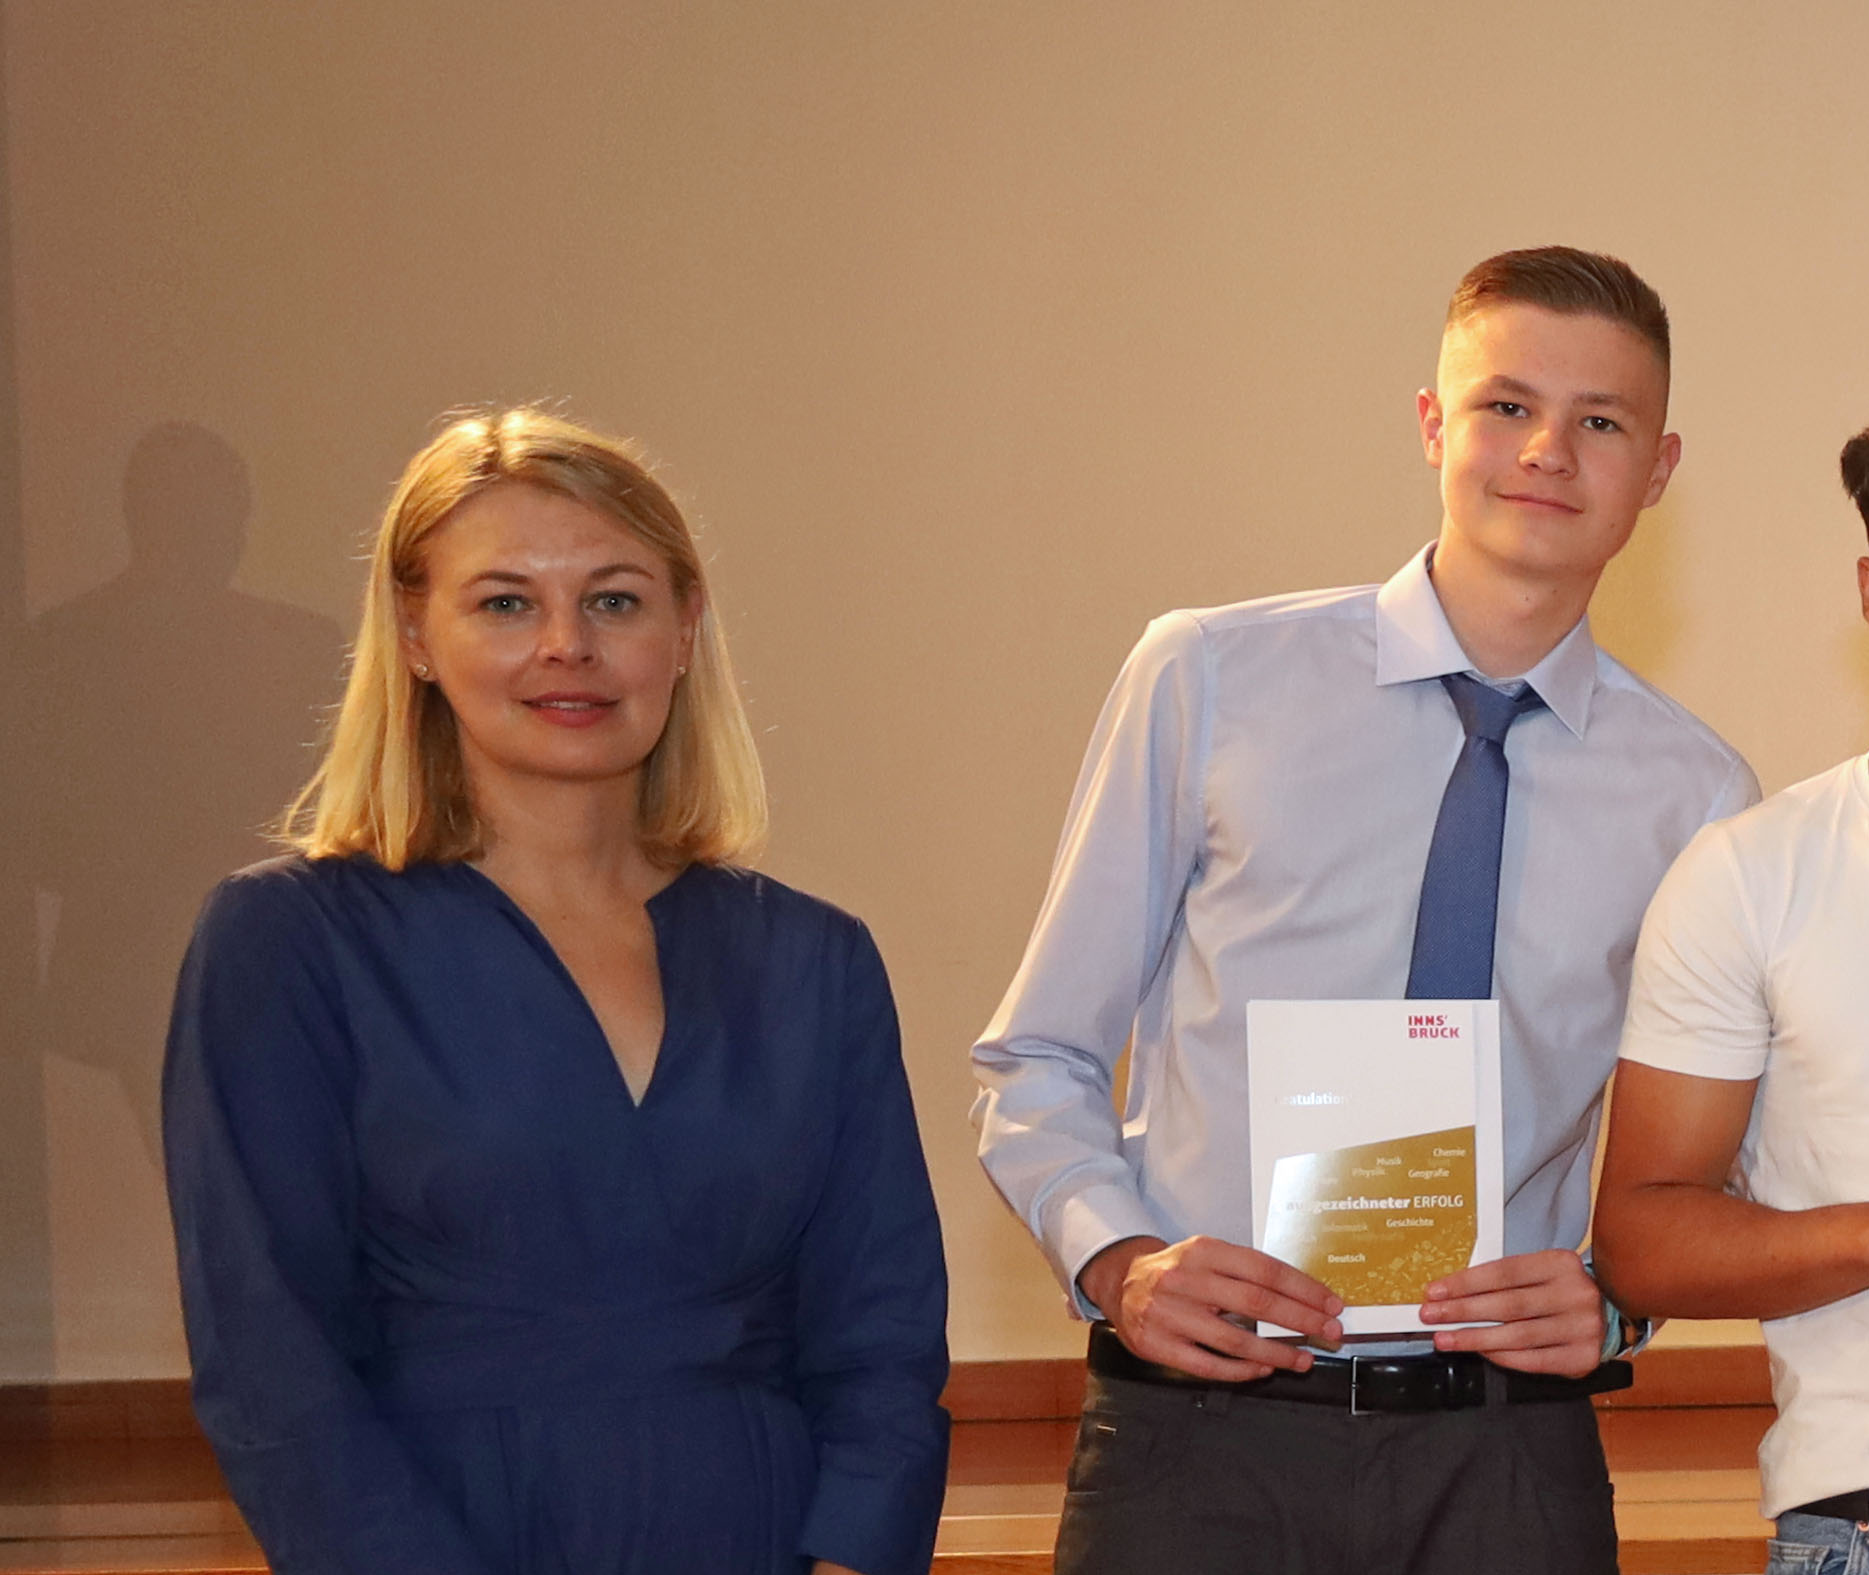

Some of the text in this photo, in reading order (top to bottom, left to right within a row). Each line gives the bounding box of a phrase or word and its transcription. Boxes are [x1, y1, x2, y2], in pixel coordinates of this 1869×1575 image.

[1408, 1026, 1459, 1038] BRUCK
[1412, 1194, 1463, 1208] ERFOLG
[1385, 1217, 1434, 1228] Geschichte
[1327, 1252, 1366, 1262] Deutsch
